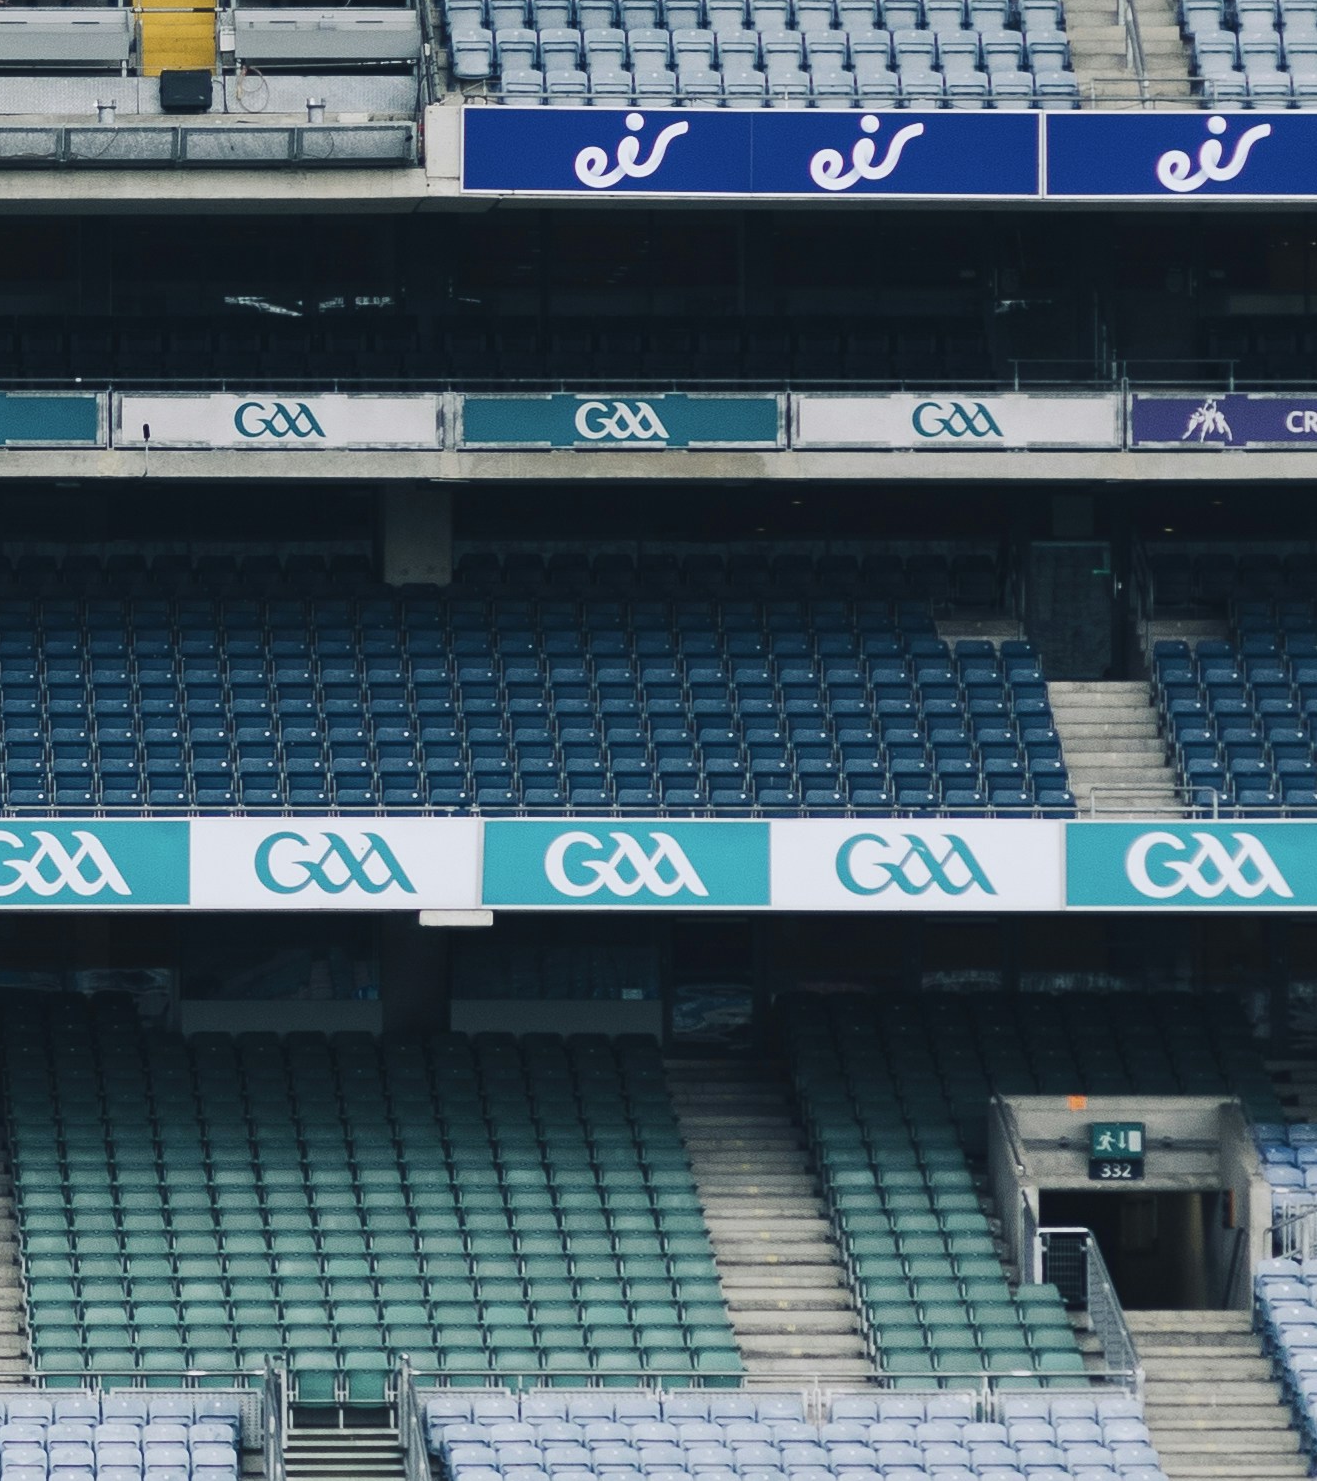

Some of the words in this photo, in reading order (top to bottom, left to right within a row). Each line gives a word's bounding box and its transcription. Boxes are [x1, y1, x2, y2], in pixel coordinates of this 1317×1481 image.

[574, 113, 689, 188] eir
[809, 114, 925, 191] eir
[1156, 115, 1273, 193] eir
[234, 401, 327, 438] GAA
[574, 400, 670, 439] GAA
[912, 402, 1004, 438] GAA
[253, 831, 419, 895] GAA
[544, 831, 710, 898] GAA
[834, 833, 1000, 897] GAA
[1124, 831, 1295, 899] GAA
[1100, 1163, 1132, 1178] 332
